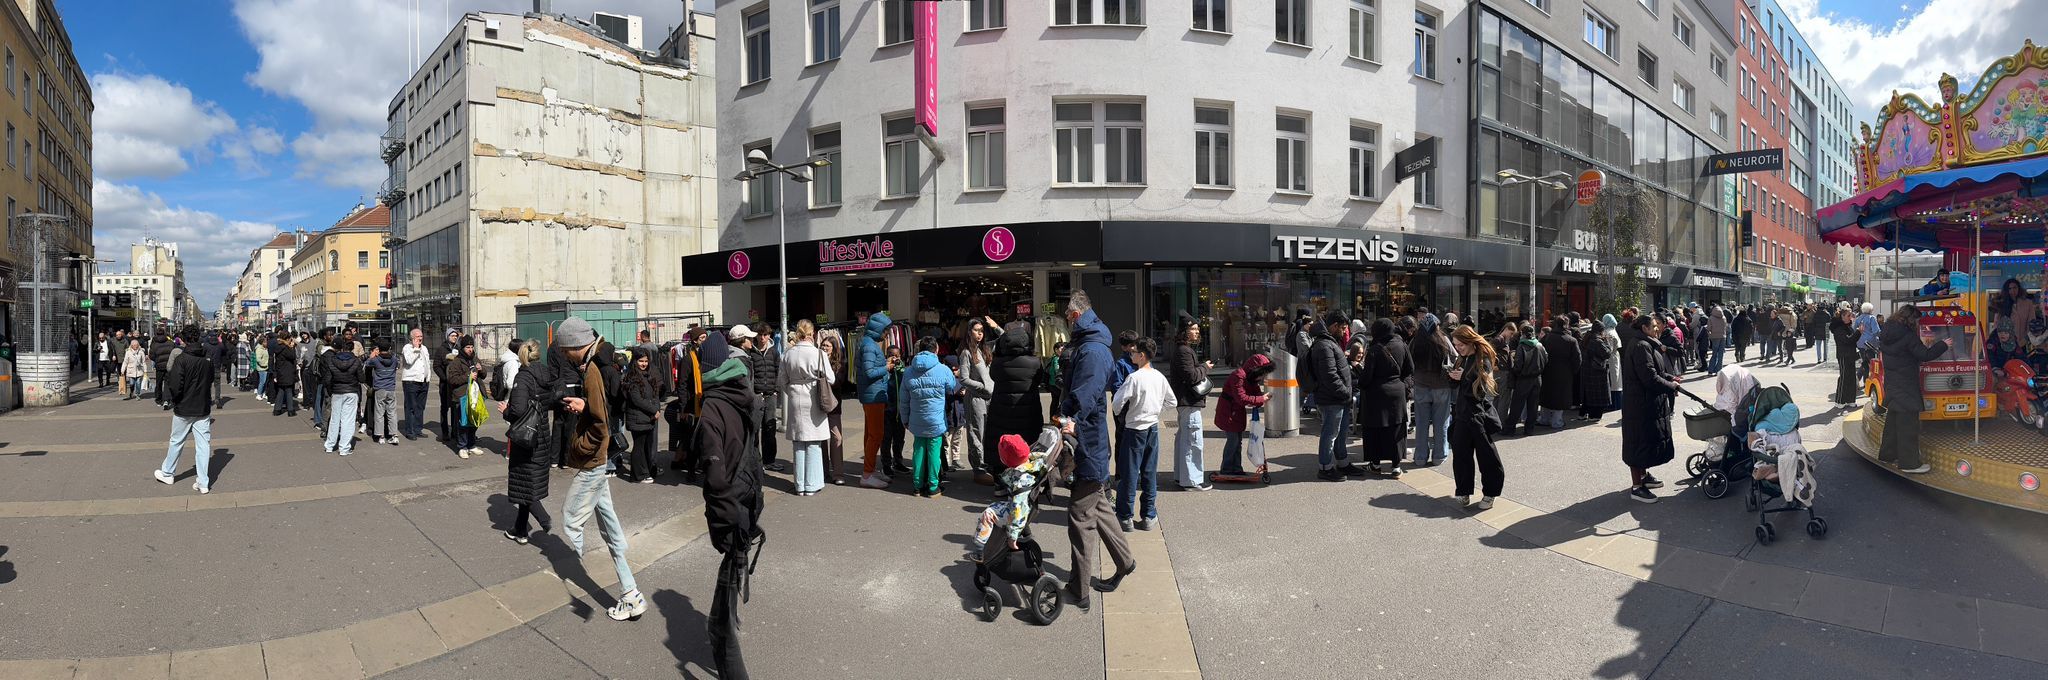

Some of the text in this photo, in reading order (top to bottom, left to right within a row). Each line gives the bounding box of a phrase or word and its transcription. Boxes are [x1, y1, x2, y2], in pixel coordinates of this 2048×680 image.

[1404, 155, 1431, 173] TEZENIS
[1729, 155, 1779, 168] NEUROTH
[1578, 180, 1601, 189] BURGER
[819, 235, 894, 262] lifestyle
[1277, 234, 1399, 263] TEZENIS
[1406, 256, 1457, 266] underwear
[1563, 257, 1591, 274] FLAME
[1647, 267, 1661, 280] 1954
[1693, 275, 1724, 288] NEUROTH
